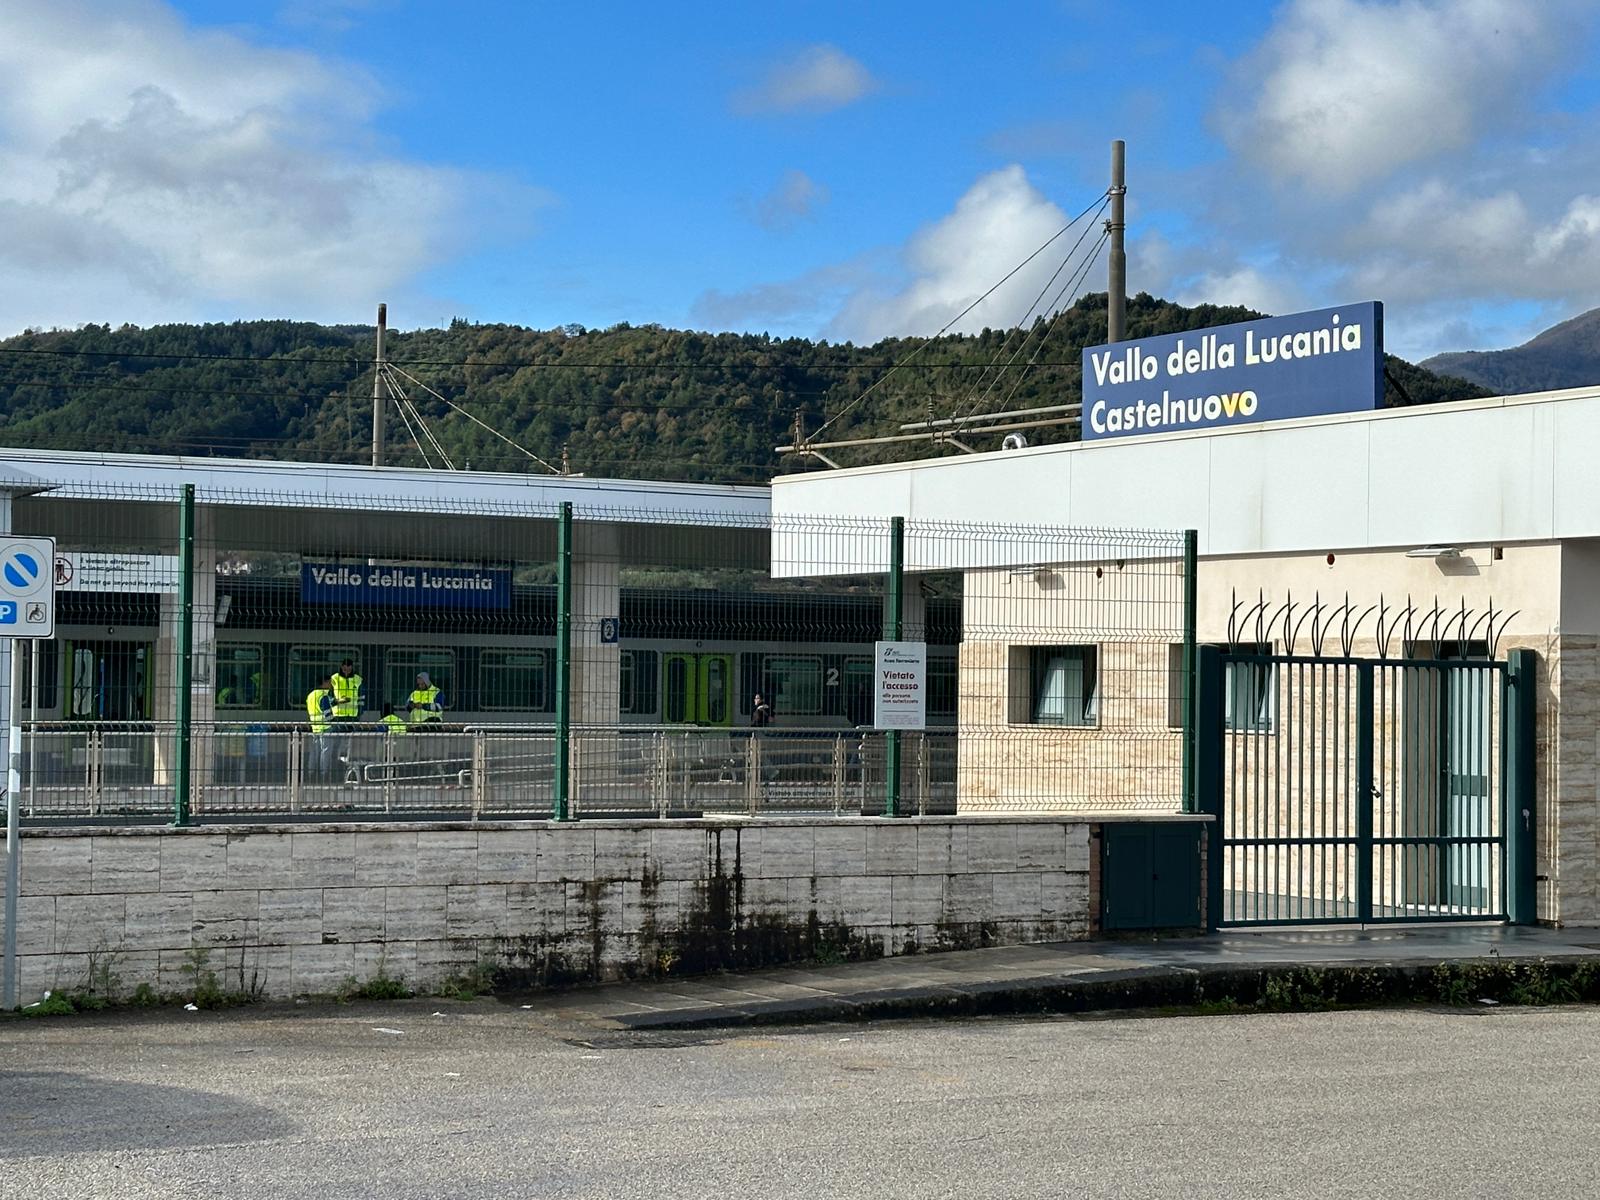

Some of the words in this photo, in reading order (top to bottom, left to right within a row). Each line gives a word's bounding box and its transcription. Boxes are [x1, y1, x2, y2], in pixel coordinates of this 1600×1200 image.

[1091, 346, 1158, 386] Vallo
[1167, 334, 1235, 377] della
[1245, 314, 1361, 365] Lucania
[1090, 391, 1258, 434] Castelnuovo
[312, 567, 362, 587] Vallo
[368, 568, 416, 588] della
[422, 571, 493, 590] Lucania
[606, 625, 612, 636] 2
[826, 668, 839, 686] 2
[882, 670, 915, 680] Vietato
[882, 681, 918, 690] l'accesso
